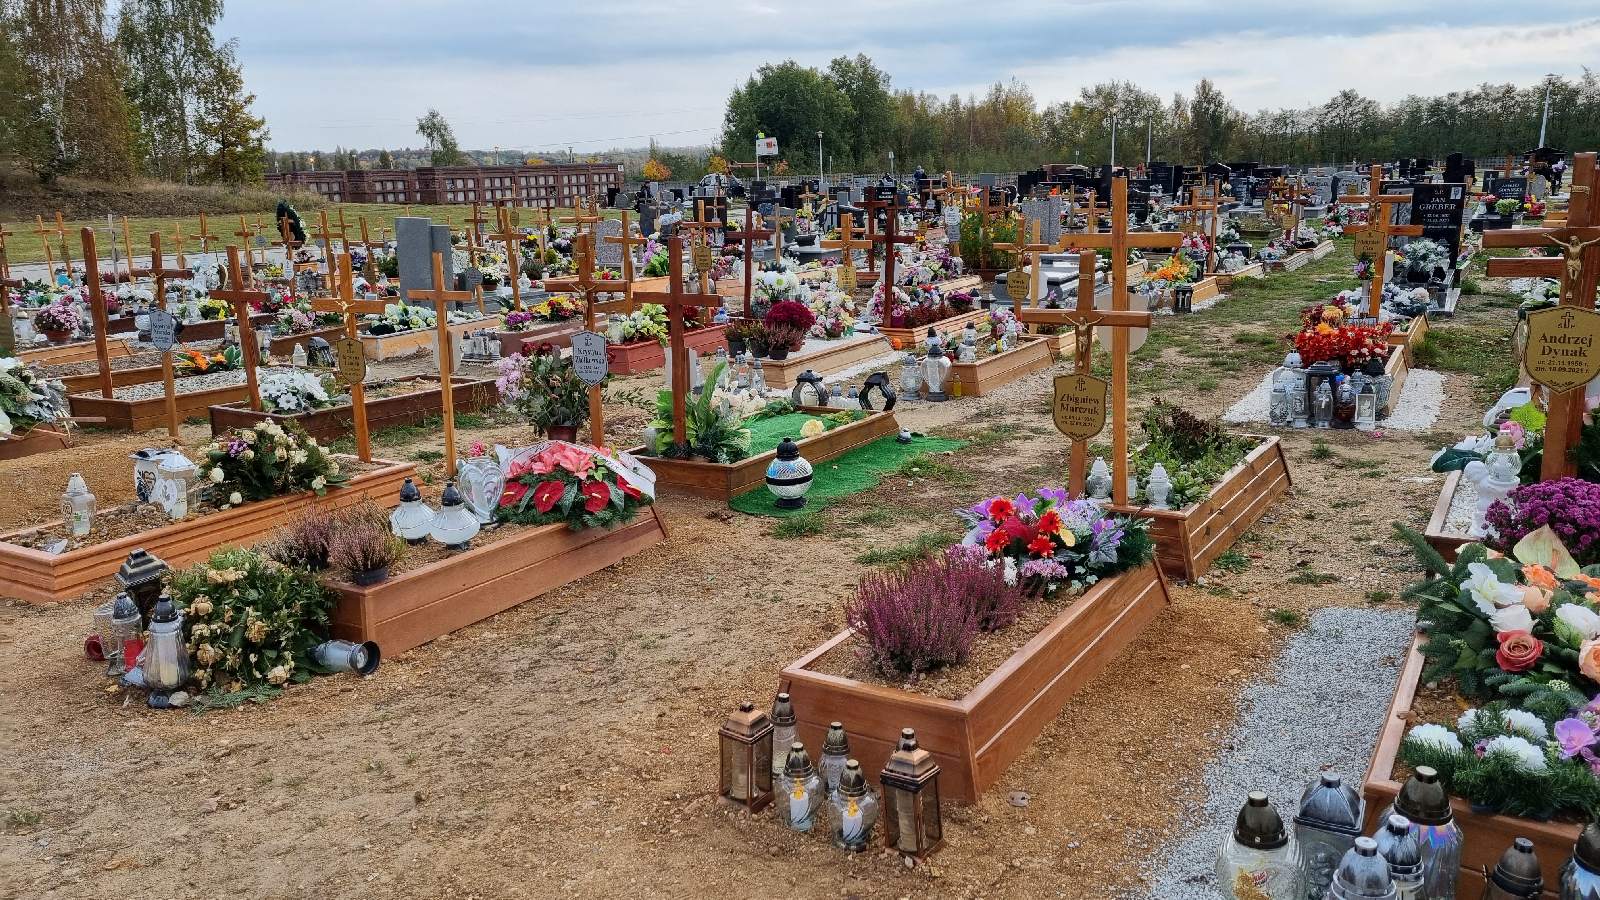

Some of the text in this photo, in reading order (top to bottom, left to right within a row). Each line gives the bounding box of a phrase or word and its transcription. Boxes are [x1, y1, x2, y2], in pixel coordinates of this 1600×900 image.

[1539, 332, 1593, 347] Andrzej
[1541, 345, 1588, 358] Dynak
[1060, 393, 1099, 405] Zbigniew
[1060, 403, 1099, 415] Marczuk
